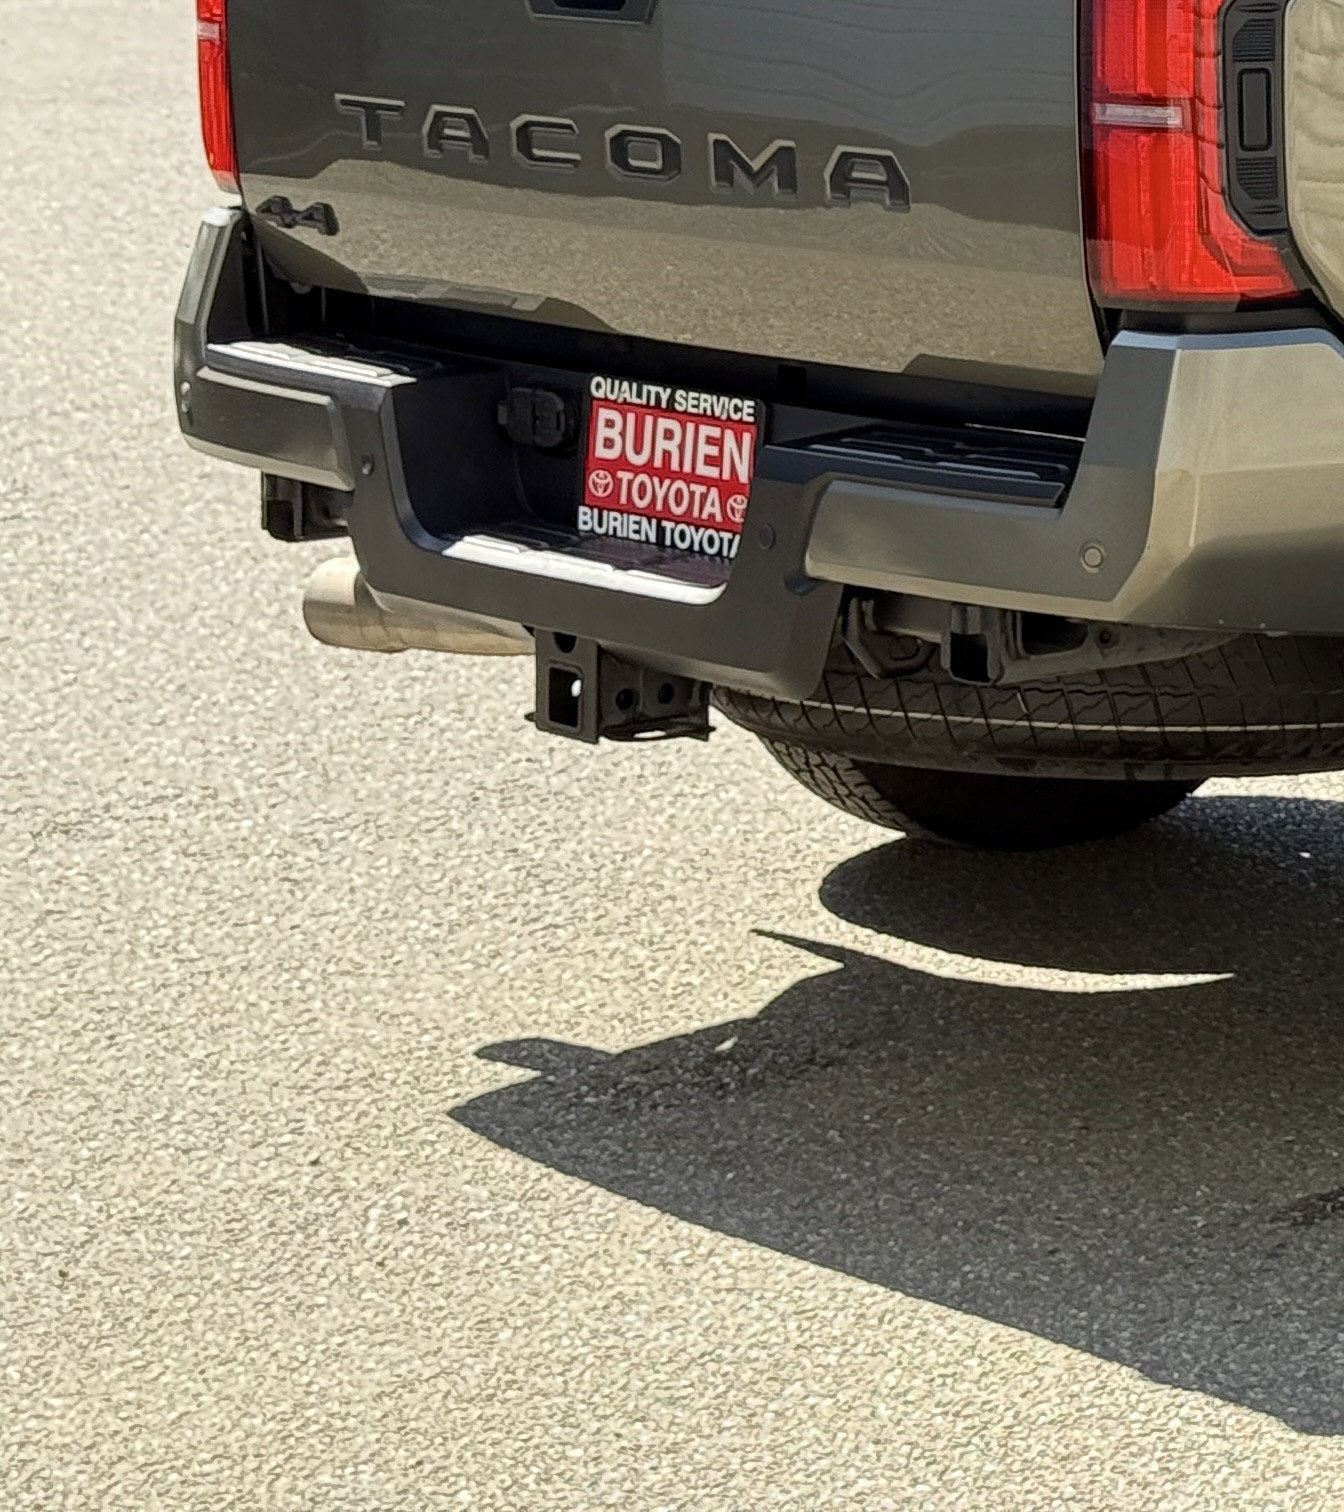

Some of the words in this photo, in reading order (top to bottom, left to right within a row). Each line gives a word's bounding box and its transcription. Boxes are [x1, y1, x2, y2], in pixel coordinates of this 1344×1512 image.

[334, 93, 911, 214] TACOMA
[590, 376, 672, 409] QUALITY
[674, 389, 755, 422] SERVICE
[595, 406, 752, 484] BURIEN
[617, 470, 724, 523] TOYOTA
[577, 505, 657, 544] BURIEN
